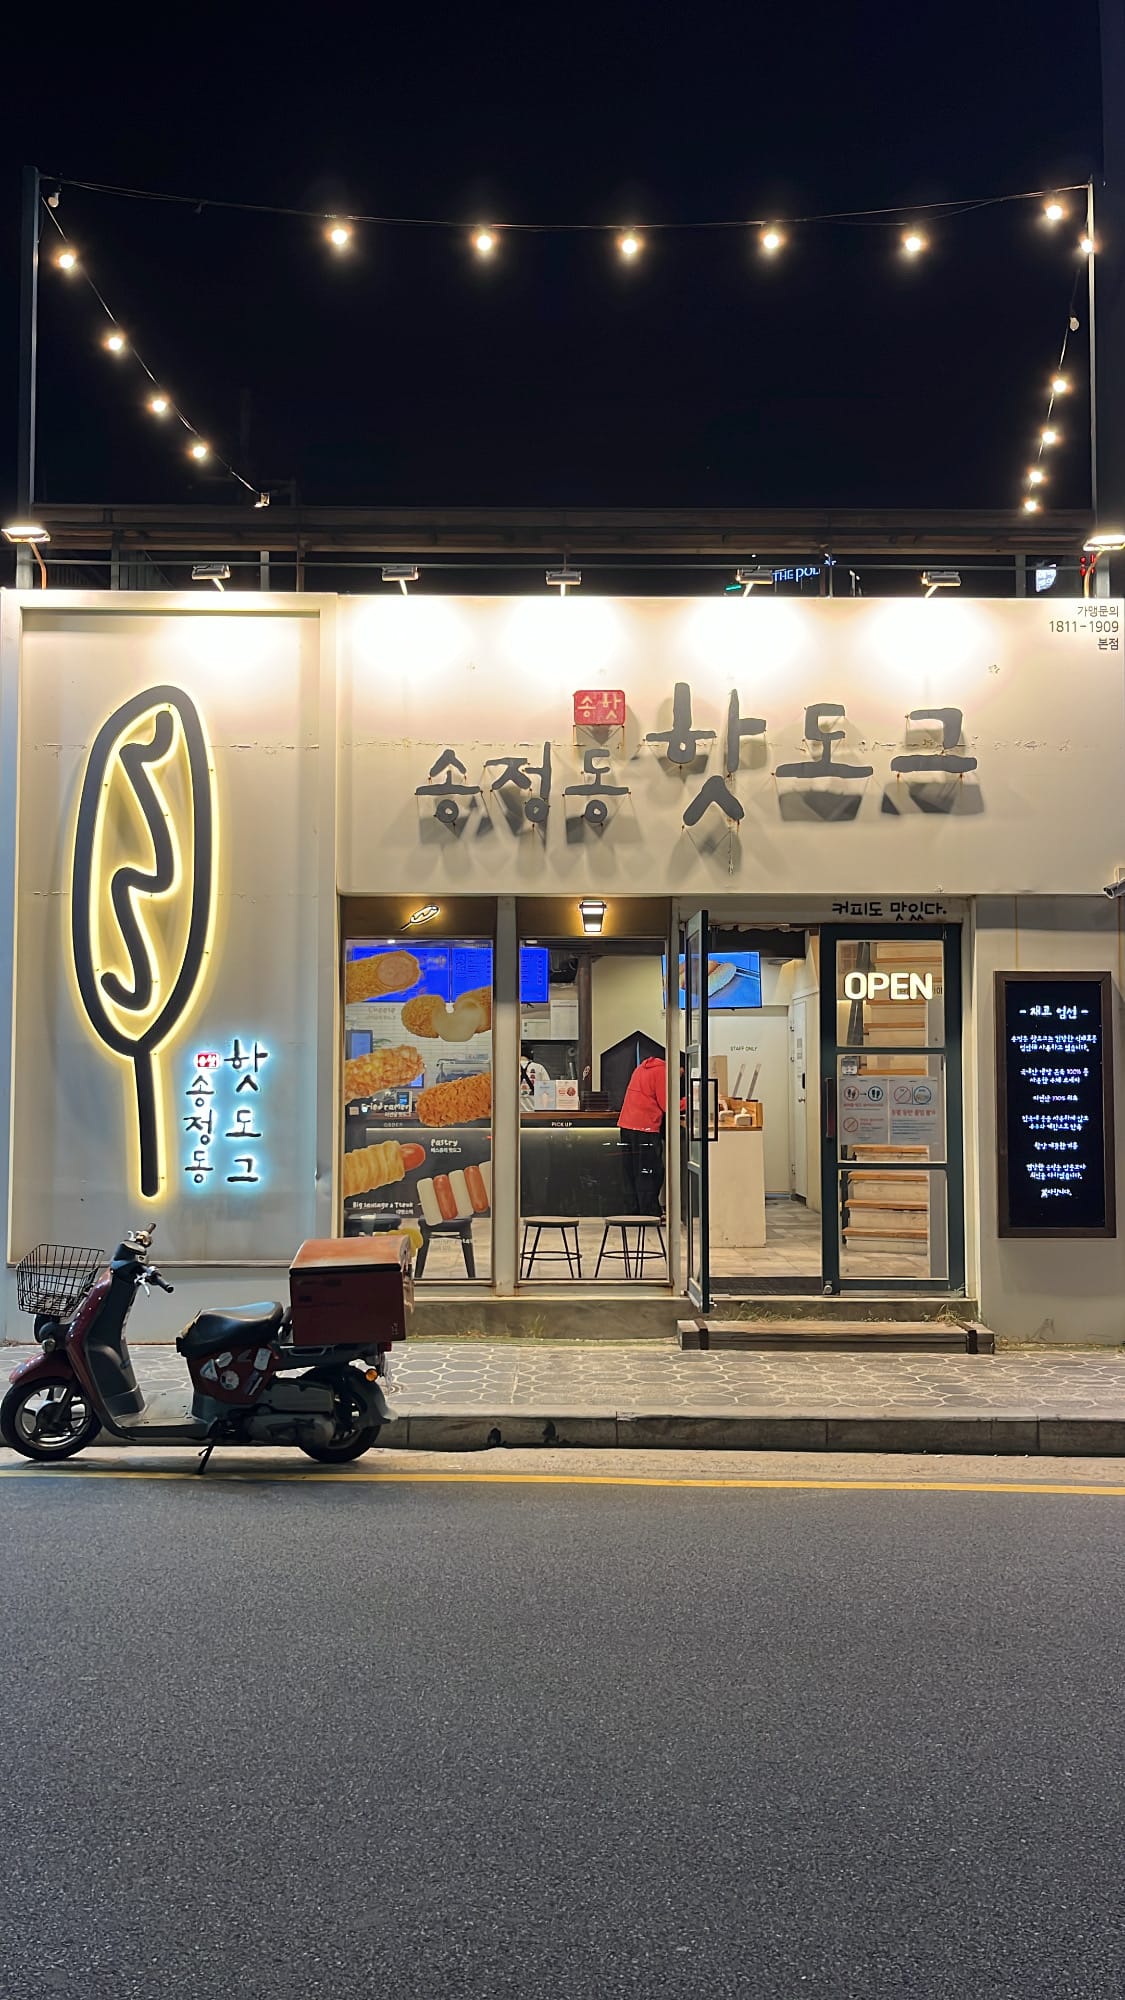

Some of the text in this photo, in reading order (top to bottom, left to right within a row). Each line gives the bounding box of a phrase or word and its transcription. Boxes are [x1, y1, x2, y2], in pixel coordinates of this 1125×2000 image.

[772, 568, 794, 582] THE
[1077, 605, 1119, 618] 가맹문의
[1048, 620, 1119, 633] 1811-1909
[1097, 637, 1119, 651] 본점
[577, 693, 621, 719] 송핫
[415, 682, 977, 826] 송정동 핫도그
[832, 901, 947, 922] 커피도 맛있다.
[845, 972, 933, 1000] OPEN
[224, 1039, 268, 1182] 핫도그
[183, 1075, 215, 1184] 송정동
[431, 1138, 458, 1146] Pastry
[352, 1201, 363, 1209] Big
